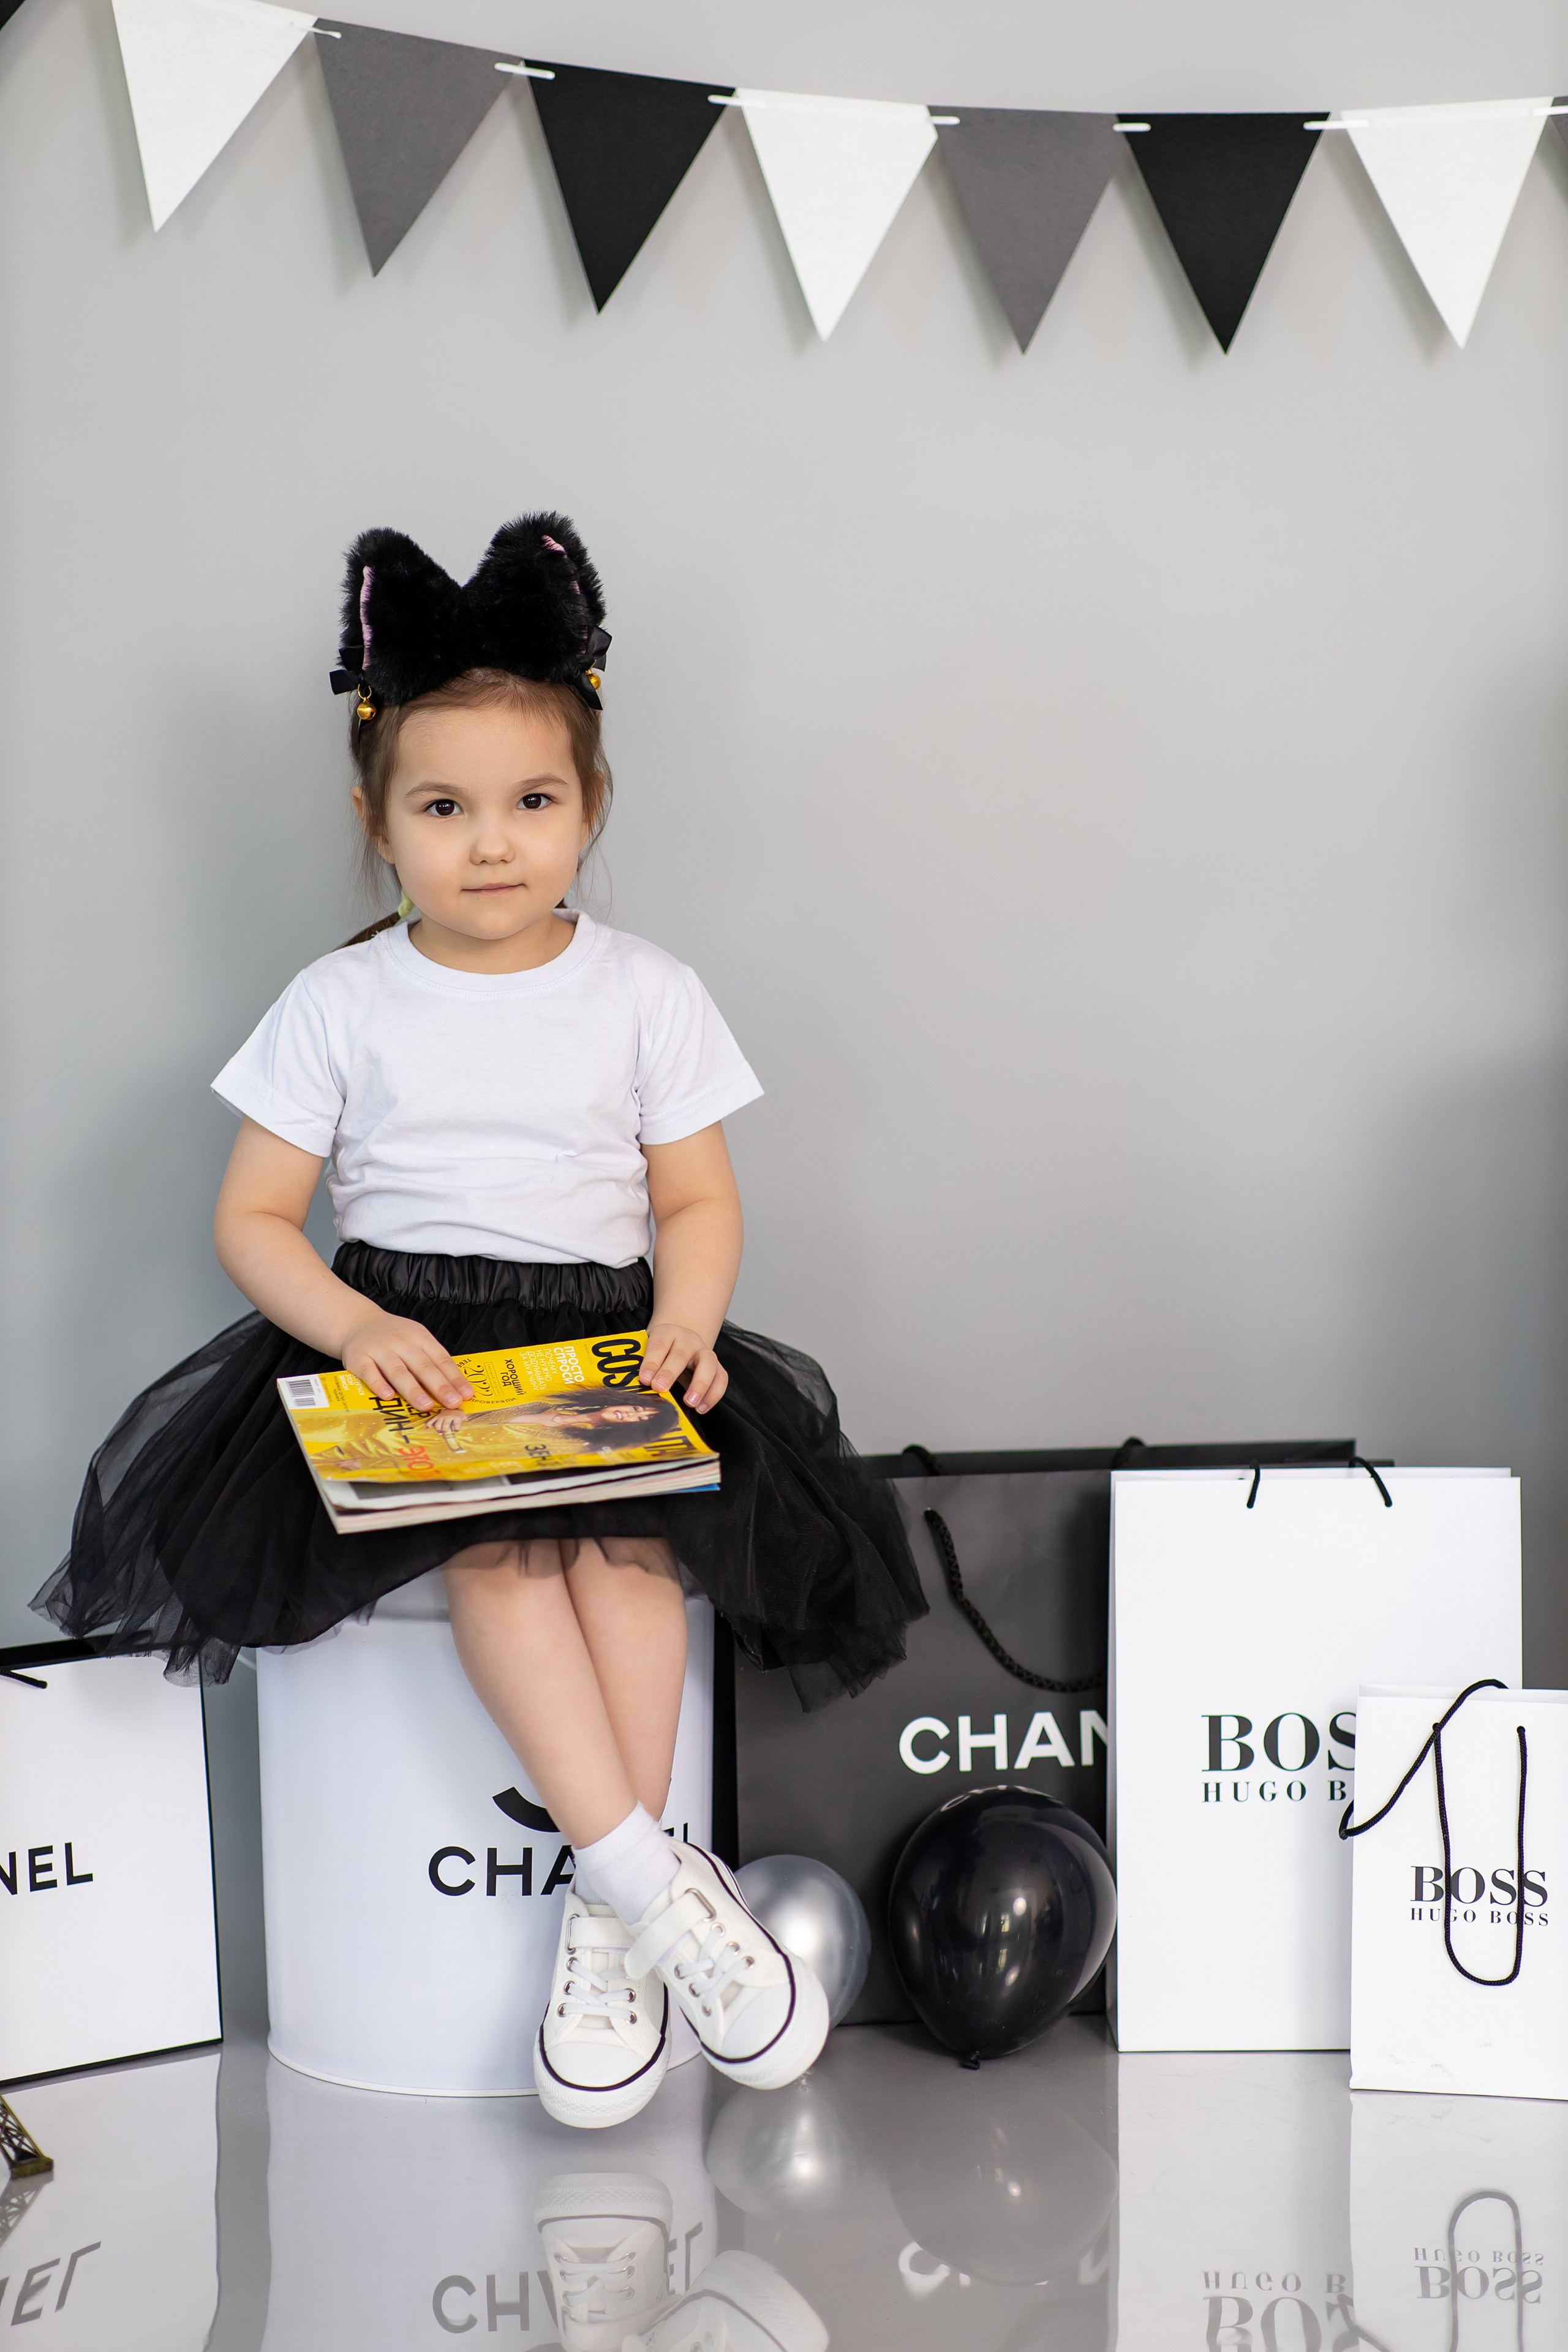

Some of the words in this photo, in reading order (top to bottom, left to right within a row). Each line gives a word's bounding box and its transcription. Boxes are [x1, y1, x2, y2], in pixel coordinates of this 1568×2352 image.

[505, 1359, 527, 1396] ХОРОШИЙ
[523, 1361, 540, 1390] МУЖЧИНУ
[526, 1351, 547, 1390] ДОДУМЫВАТЬ
[539, 1359, 552, 1382] НУЖНО
[543, 1348, 559, 1374] ПОЧЕМУ
[553, 1347, 575, 1384] СПРОСИ
[564, 1346, 585, 1382] ПРОСТО
[500, 1372, 512, 1387] ГОД
[369, 1396, 414, 1432] ДИН
[899, 1709, 1108, 1774] CHAN
[1201, 1712, 1356, 1772] BOS
[1201, 1779, 1307, 1803] HUGO
[1410, 1866, 1548, 1907] BOSS
[1410, 1907, 1477, 1923] HUGO
[1489, 1910, 1549, 1927] BOSS
